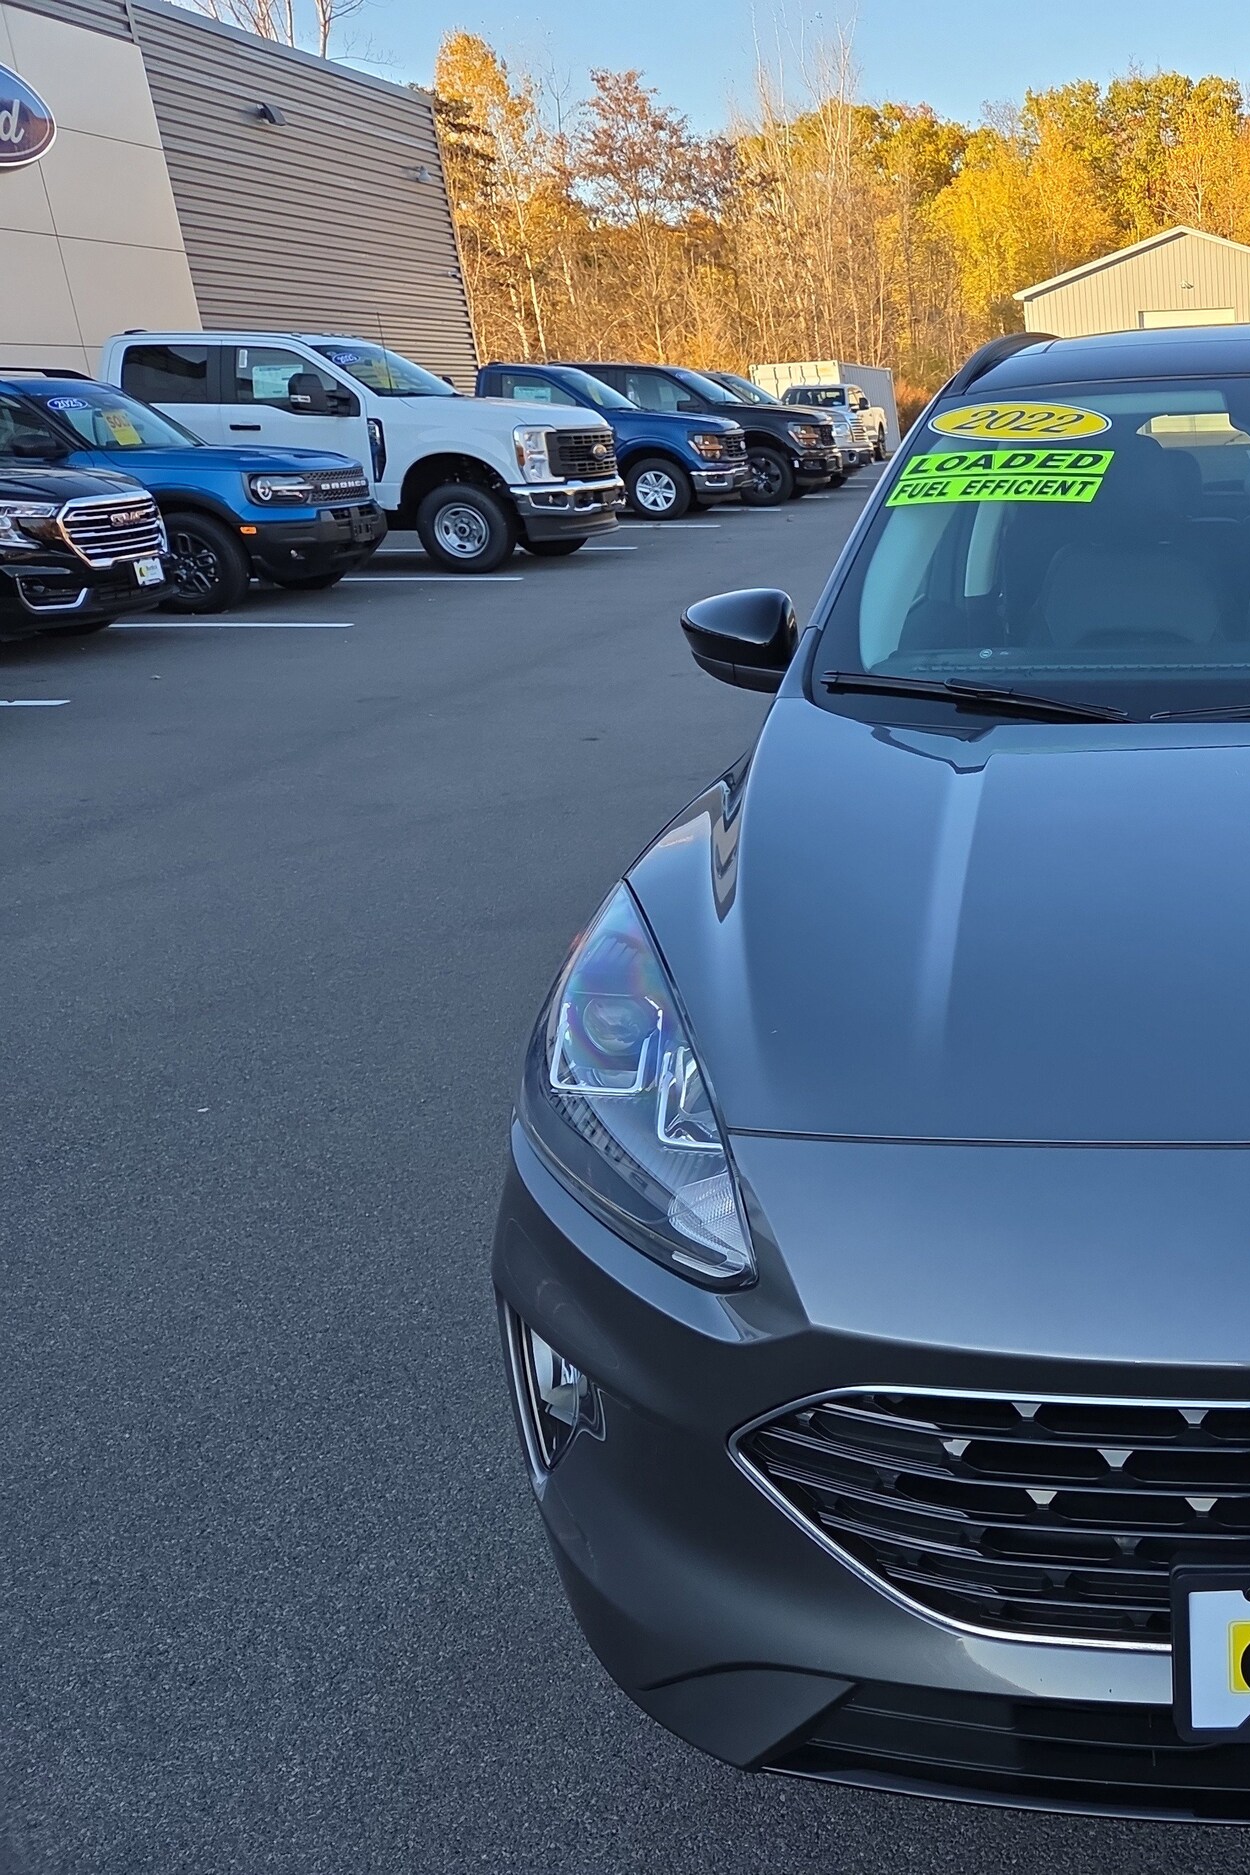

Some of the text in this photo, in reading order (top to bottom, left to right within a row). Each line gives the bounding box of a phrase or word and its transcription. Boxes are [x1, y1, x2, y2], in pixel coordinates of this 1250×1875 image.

[53, 400, 83, 409] 2025
[951, 409, 1085, 433] 2022
[906, 453, 1107, 476] LOADED
[321, 480, 367, 490] BRONCO
[892, 479, 1096, 502] FUEL EFFICIENT
